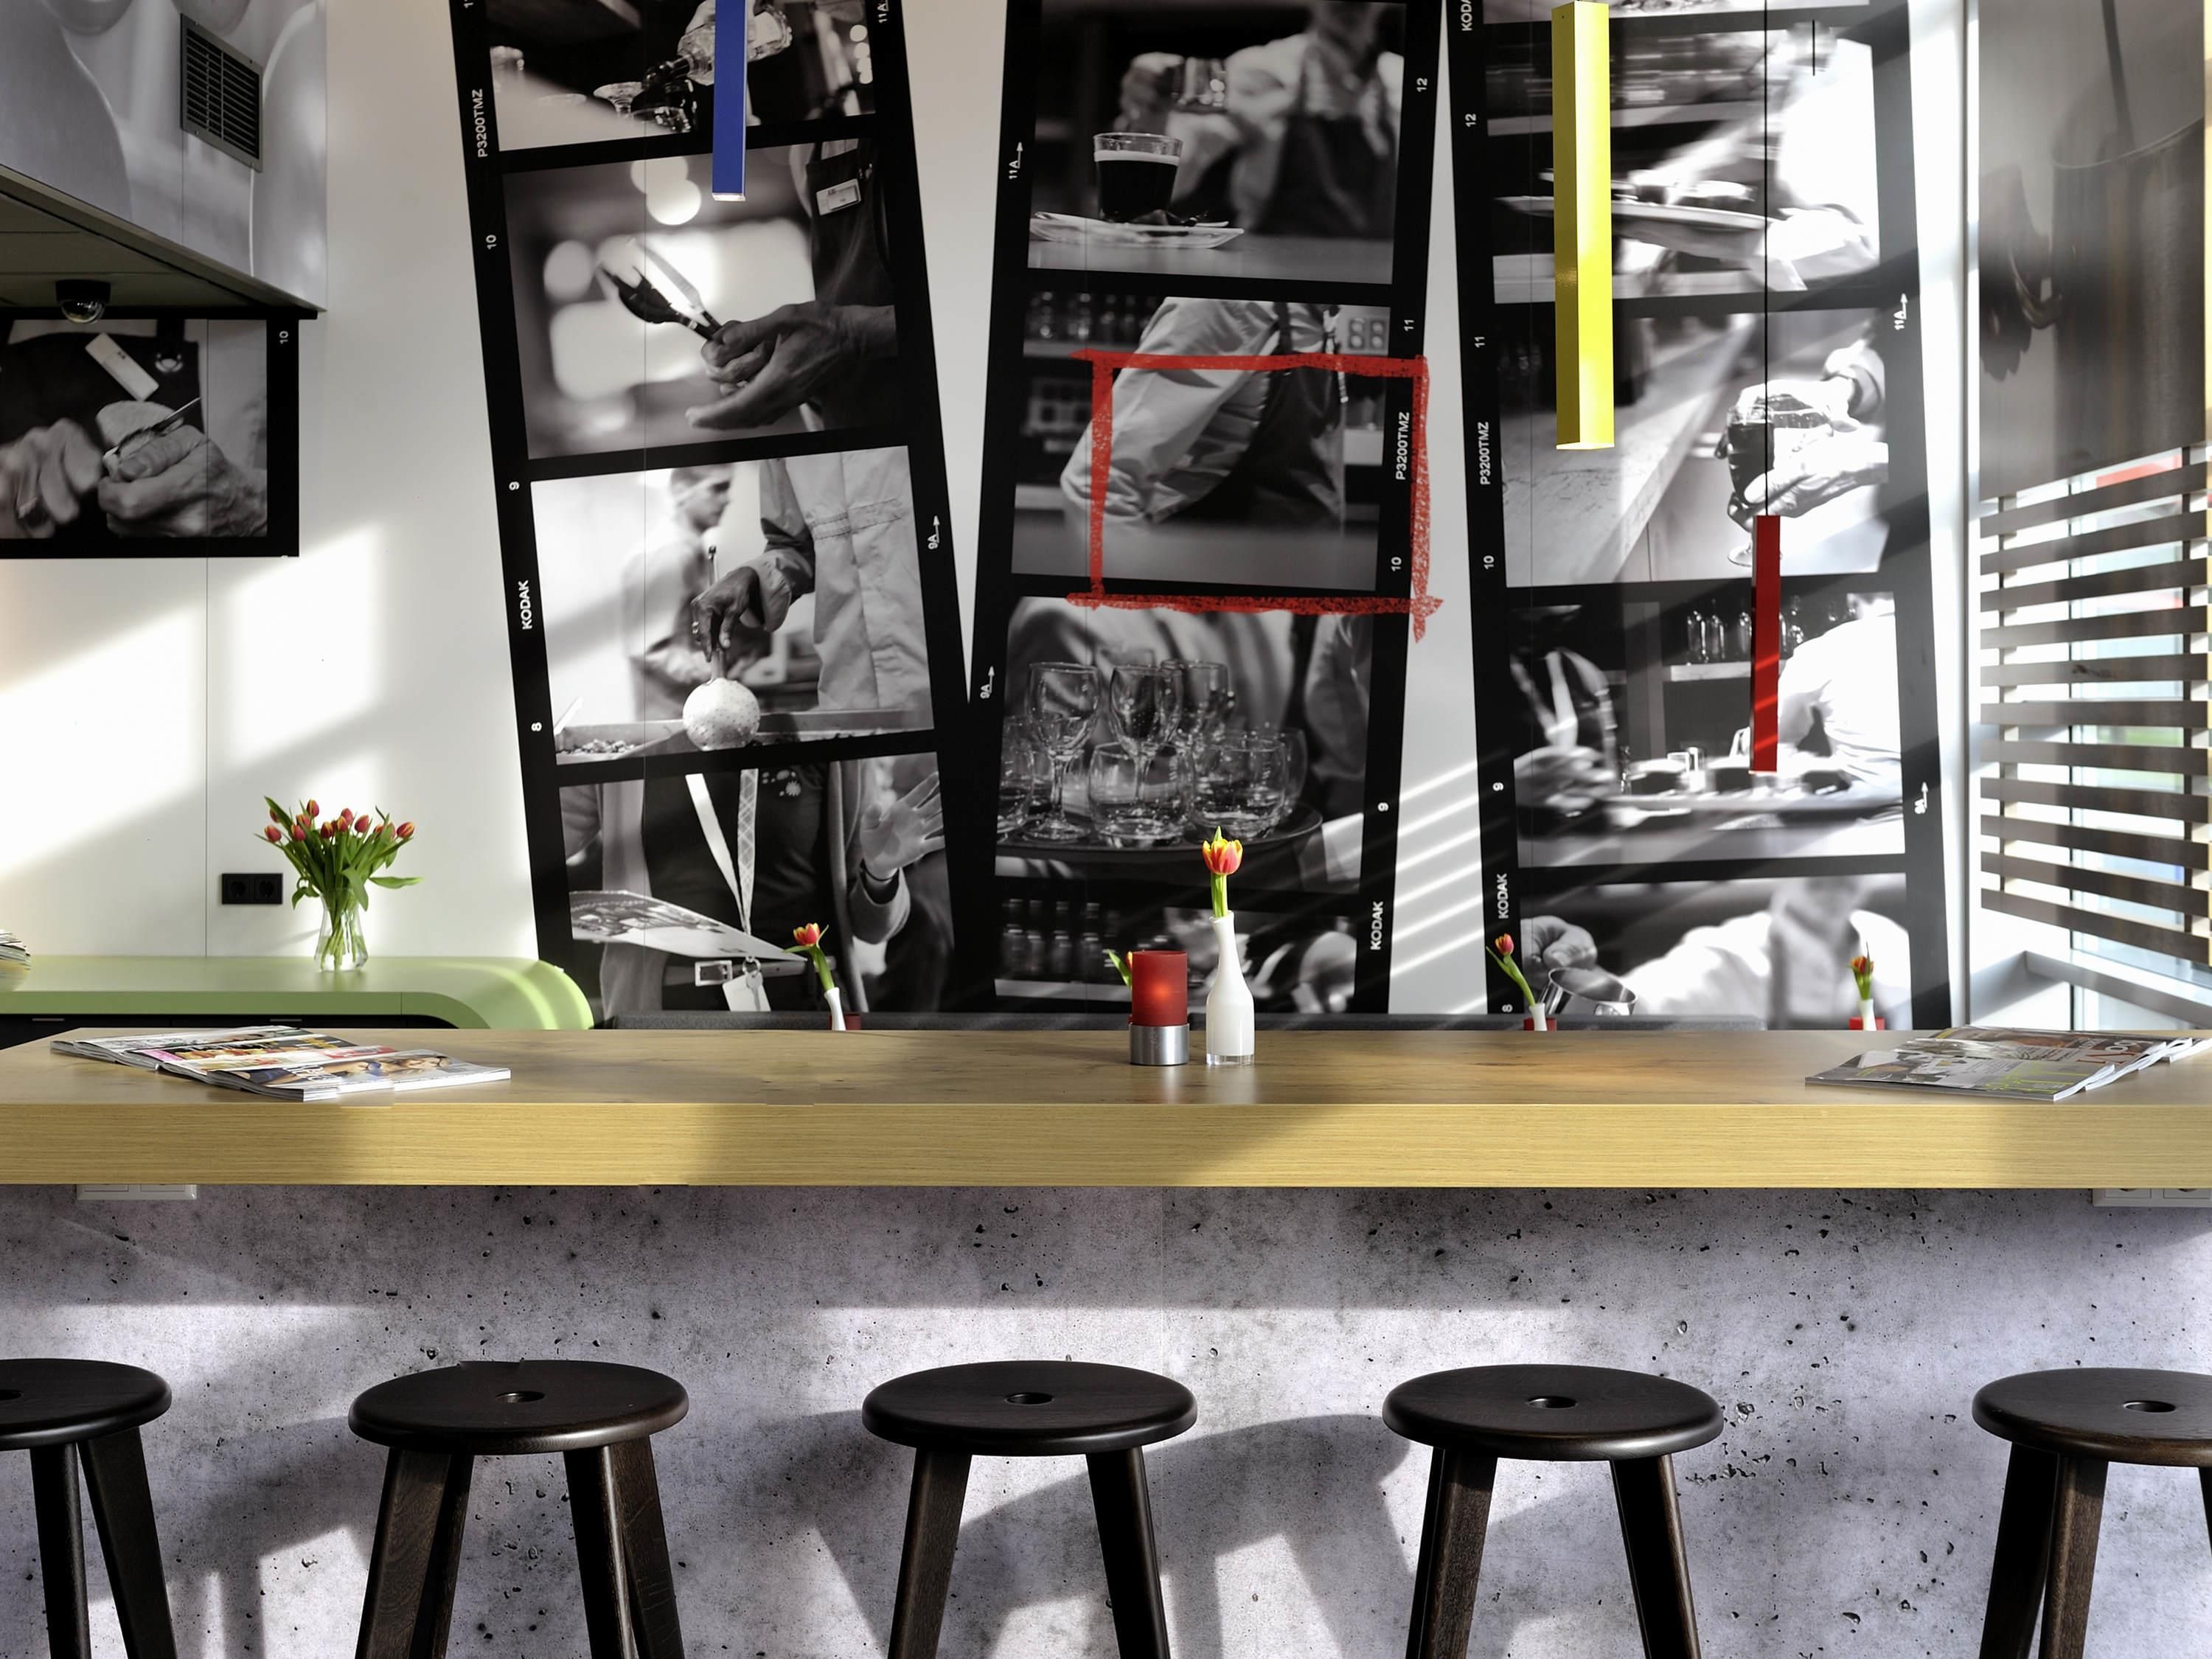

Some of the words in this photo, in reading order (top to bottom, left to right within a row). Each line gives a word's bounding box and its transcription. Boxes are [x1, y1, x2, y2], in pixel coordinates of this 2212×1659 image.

[1416, 77, 1427, 92] 12
[471, 88, 488, 158] P3200TMZ
[1465, 114, 1476, 128] 12
[1009, 159, 1020, 179] 11A
[485, 234, 497, 249] 10
[1403, 319, 1414, 331] 11
[279, 330, 289, 344] 10
[1474, 336, 1485, 348] 11
[1395, 411, 1410, 480] P3200TMZ
[1478, 422, 1491, 485] P3200TMZ
[509, 481, 520, 491] 9
[928, 532, 939, 550] 9A
[1391, 557, 1402, 571] 10
[1483, 555, 1495, 570] 10
[518, 580, 532, 630] KODAK
[980, 683, 992, 699] 9A
[531, 722, 543, 732] 8
[1492, 782, 1504, 791] 9
[1377, 802, 1389, 812] 9
[1497, 873, 1509, 919] KODAK
[1370, 901, 1383, 950] KODAK
[1501, 1004, 1513, 1012] 8
